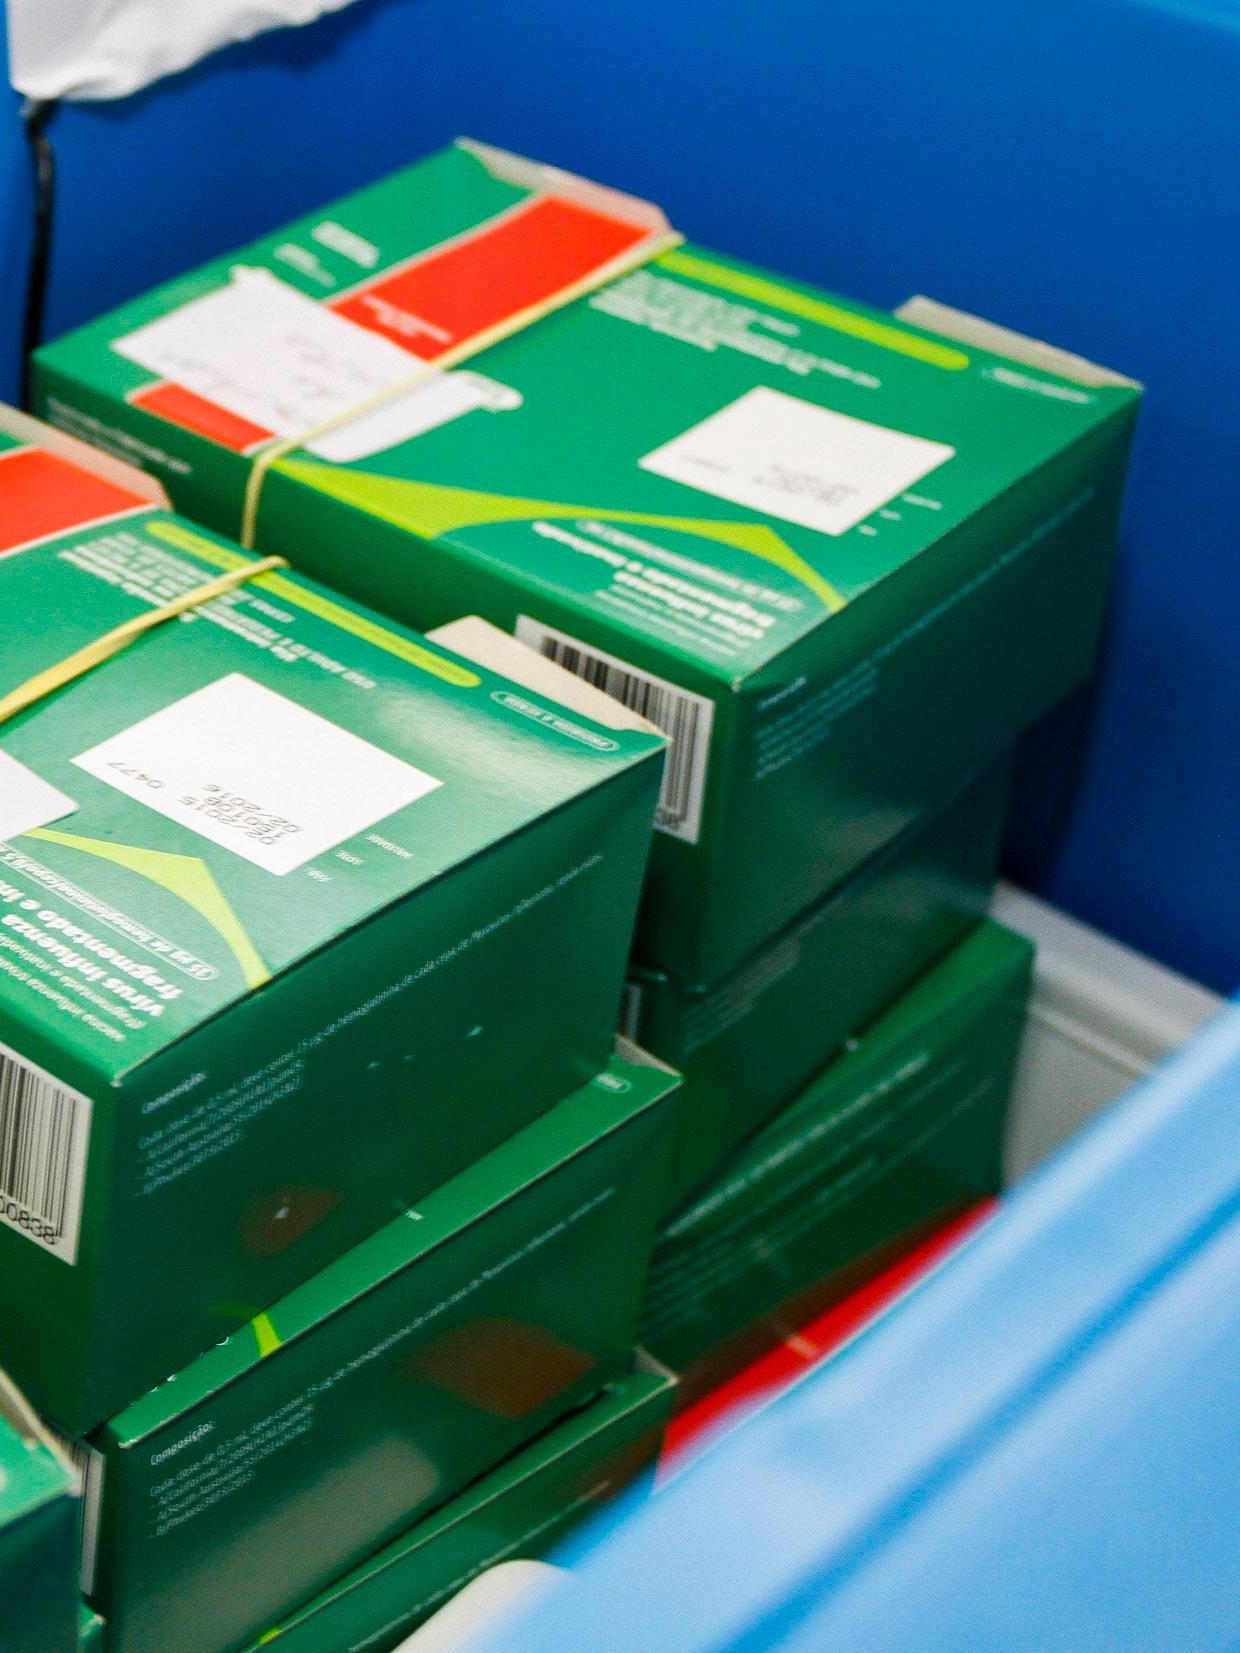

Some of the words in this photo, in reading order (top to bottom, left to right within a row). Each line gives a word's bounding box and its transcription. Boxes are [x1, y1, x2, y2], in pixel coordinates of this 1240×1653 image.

[177, 795, 277, 845] 02/2015
[201, 783, 301, 832] 02/2016
[17, 896, 43, 912] e
[29, 905, 189, 1002] fragmentado
